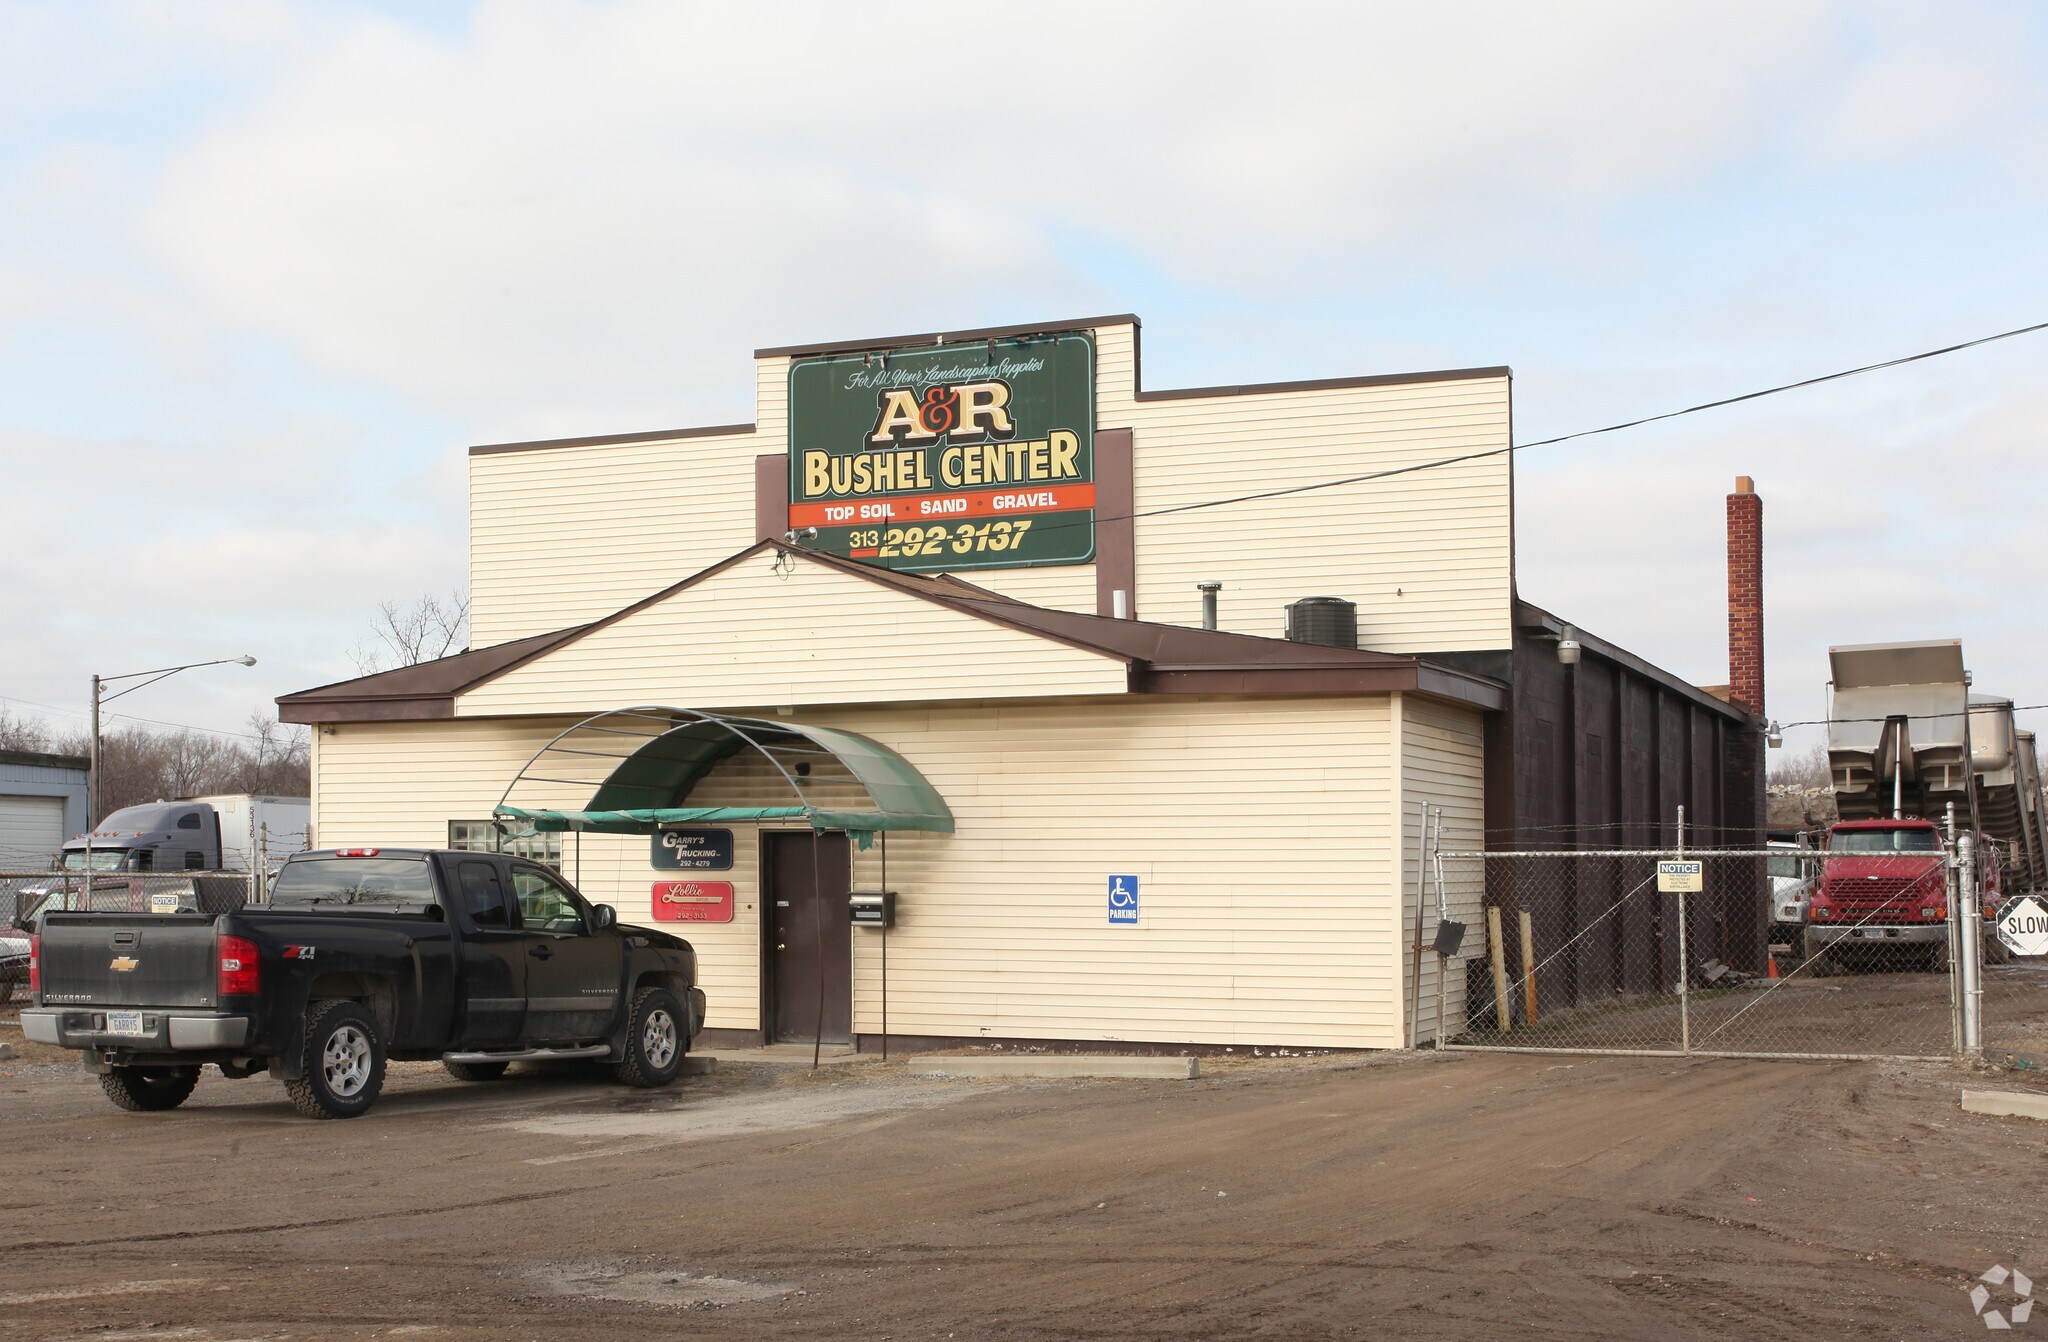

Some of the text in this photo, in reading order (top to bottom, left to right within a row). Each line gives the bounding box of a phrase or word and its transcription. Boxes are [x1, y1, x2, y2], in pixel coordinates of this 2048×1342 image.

[844, 357, 1045, 390] For All Your Landscaping Supplies
[870, 381, 1013, 443] A&R
[804, 430, 1080, 497] BUSHEL CENTER
[824, 492, 1058, 521] TOP SOIL SAND GRAVEL
[849, 520, 1032, 558] 313 292-3137
[662, 831, 705, 848] GARRY'S
[675, 844, 716, 860] TRUCKING
[1661, 864, 1699, 873] NOTICE
[1110, 909, 1137, 919] PARKING
[2008, 916, 2048, 934] SLOW
